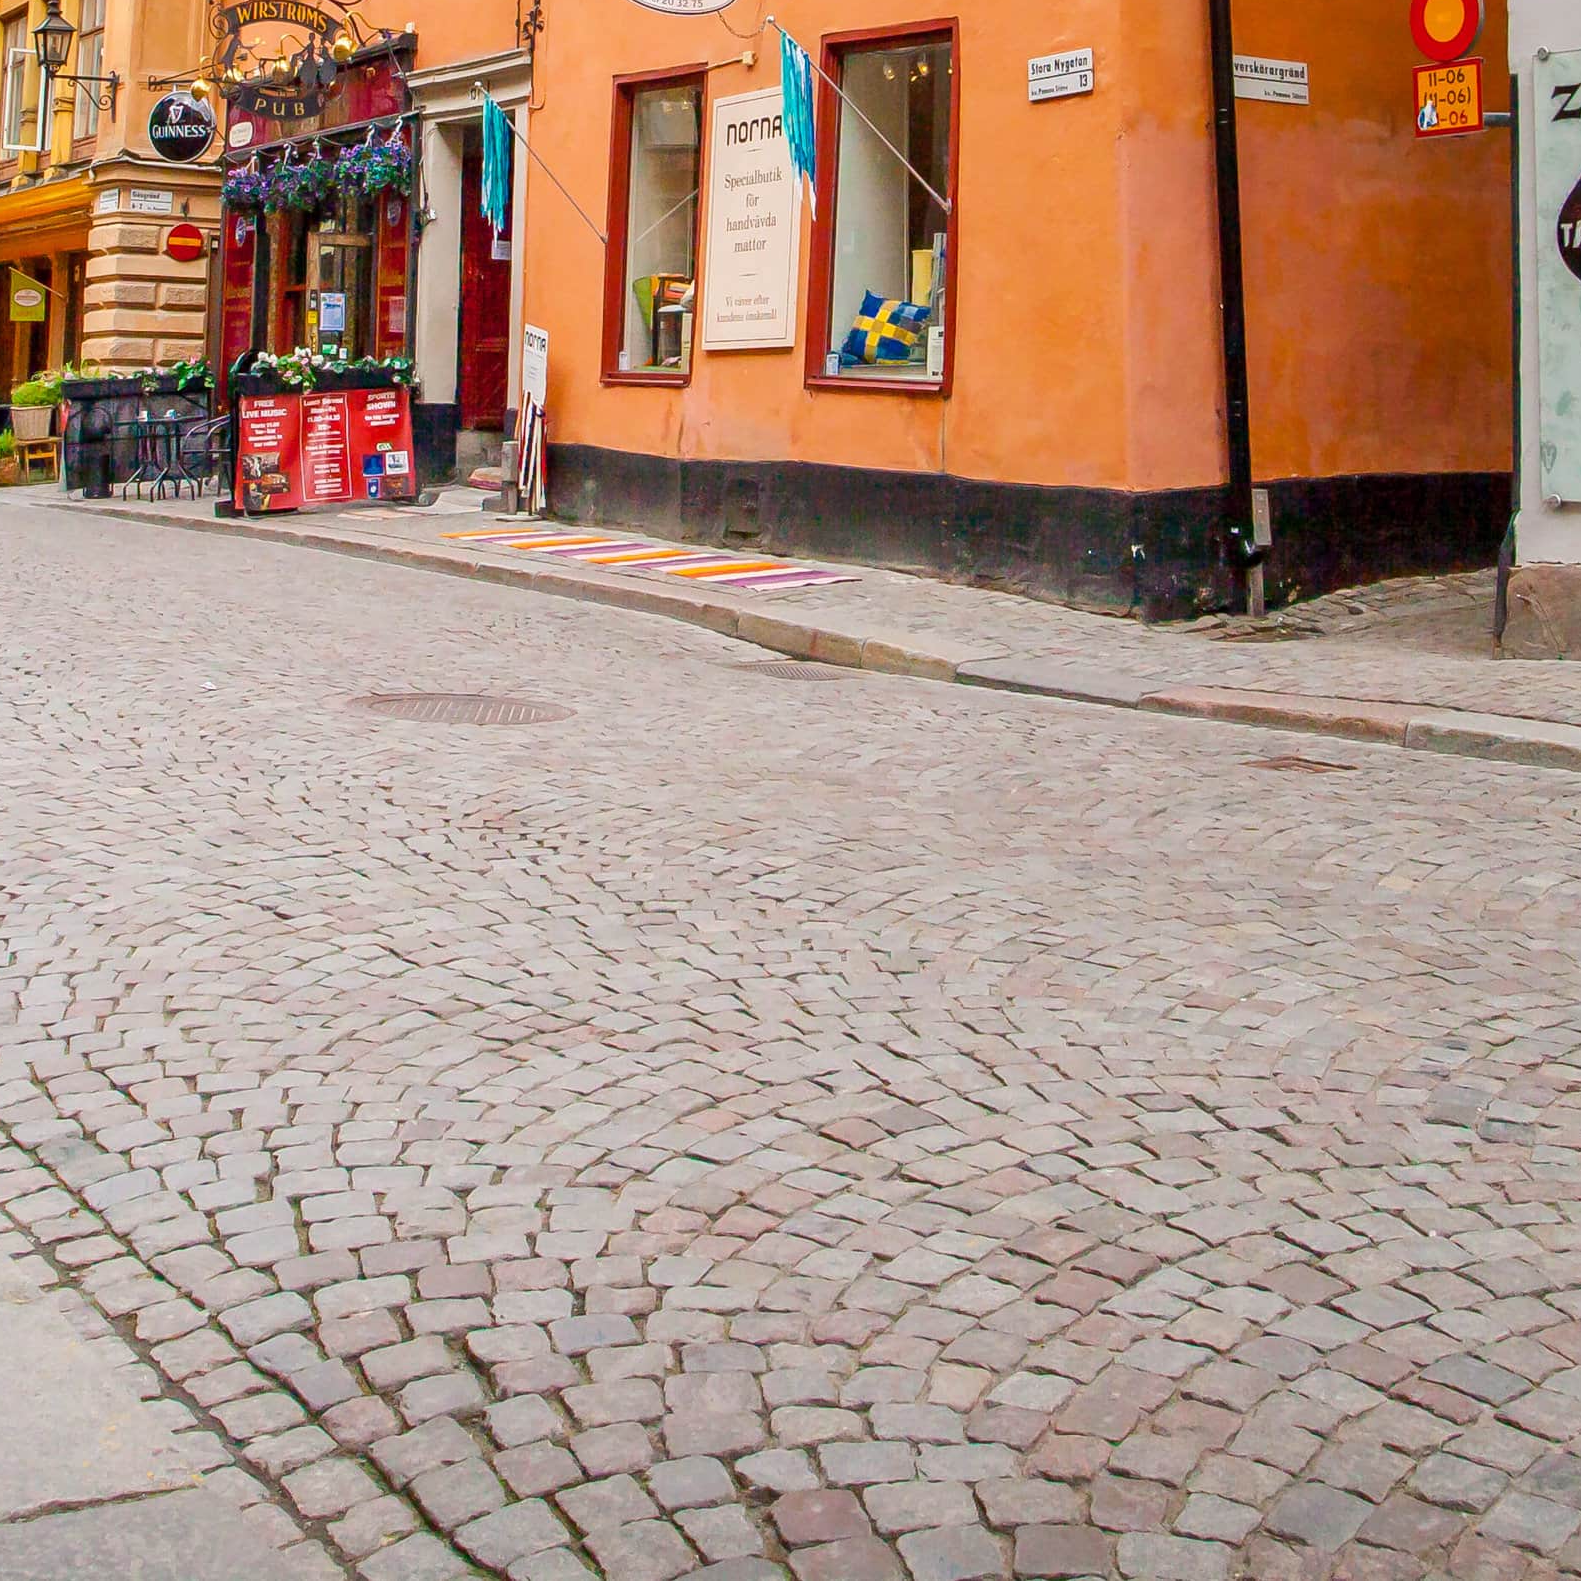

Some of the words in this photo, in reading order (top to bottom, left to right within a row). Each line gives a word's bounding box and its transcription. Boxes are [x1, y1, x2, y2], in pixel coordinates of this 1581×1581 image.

[691, 0, 703, 8] 75
[1031, 63, 1051, 75] Stora
[1054, 56, 1088, 73] Nygatan
[1233, 60, 1305, 79] verskärargränd
[1079, 74, 1088, 87] 13
[1428, 68, 1465, 87] 11-06
[254, 98, 305, 116] PUB
[152, 124, 207, 139] GUINNESS
[724, 167, 783, 191] Specialbutik
[745, 193, 759, 208] för
[726, 212, 777, 232] handvävda
[734, 238, 767, 253] mattor
[242, 410, 259, 419] LIVE
[260, 408, 287, 417] MUSIC
